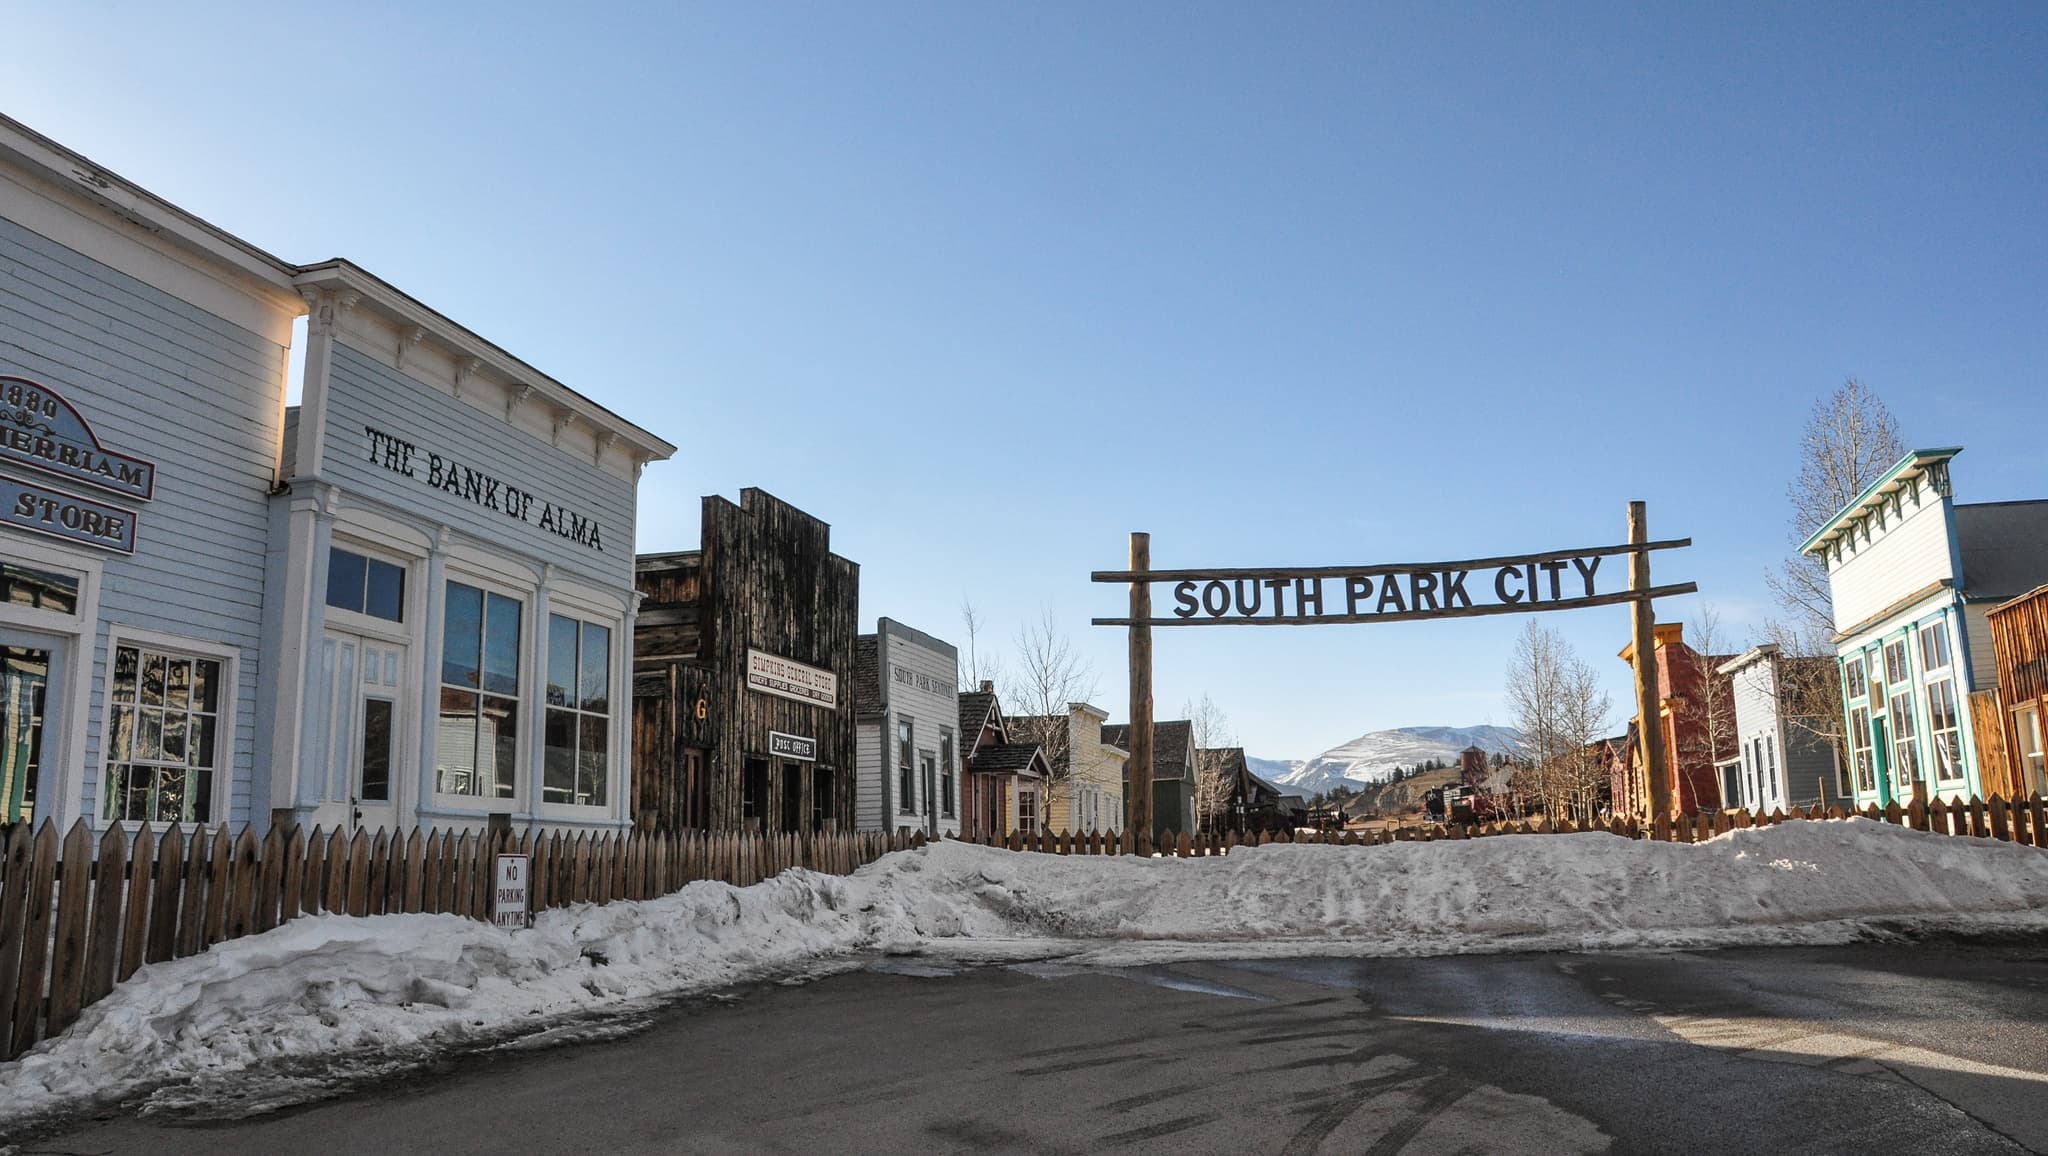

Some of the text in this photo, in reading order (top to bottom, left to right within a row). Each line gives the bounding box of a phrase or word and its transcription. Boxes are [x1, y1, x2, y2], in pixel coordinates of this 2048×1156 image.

[365, 425, 603, 551] THE BANK OF ALMA
[15, 492, 124, 543] STORE
[1173, 555, 1602, 618] SOUTH PARK CITY
[753, 655, 832, 691] SIMPKINS GENERAL STORE
[895, 667, 913, 686] SOUTH
[915, 674, 930, 691] PARK
[696, 698, 706, 719] G
[506, 865, 518, 881] NO
[498, 888, 524, 903] PARKING
[497, 911, 524, 927] ANYTIME
